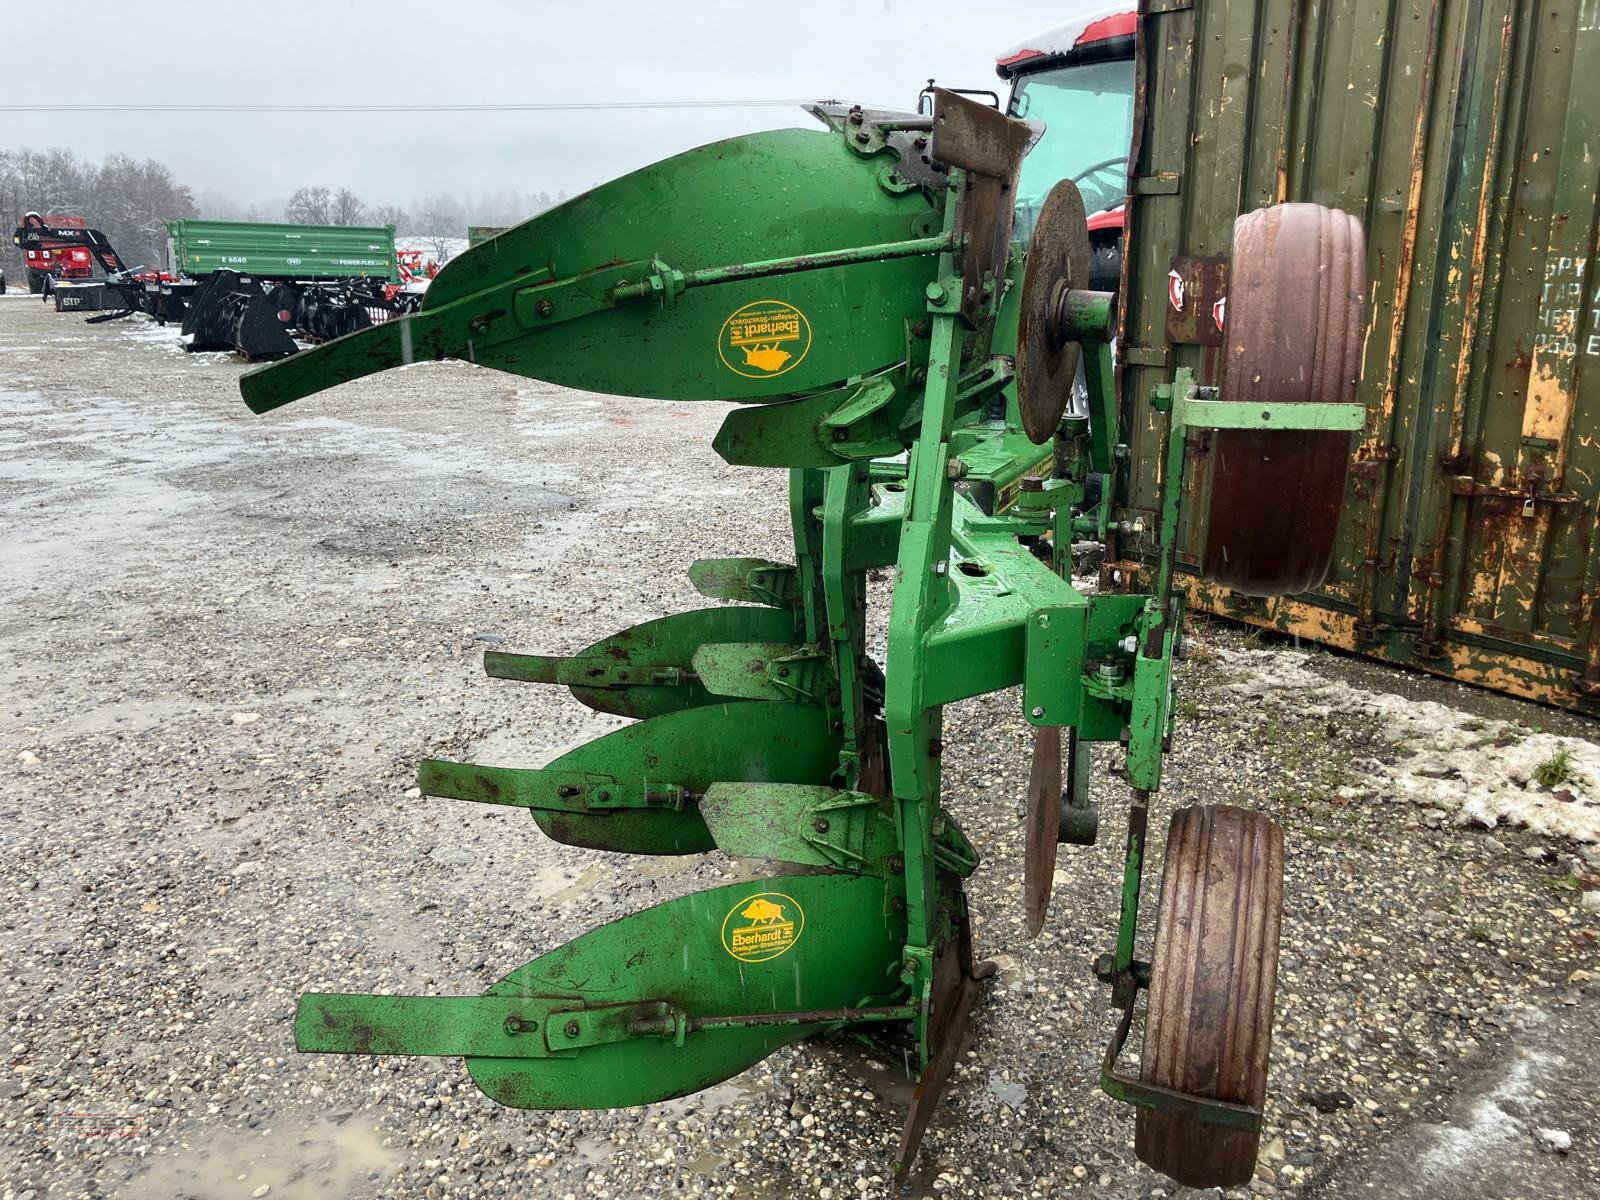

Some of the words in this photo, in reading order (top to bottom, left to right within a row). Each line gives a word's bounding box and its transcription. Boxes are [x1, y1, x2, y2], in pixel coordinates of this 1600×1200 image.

[63, 297, 81, 306] SIP
[744, 320, 799, 338] Eberhardt
[732, 929, 782, 947] Eberhardt
